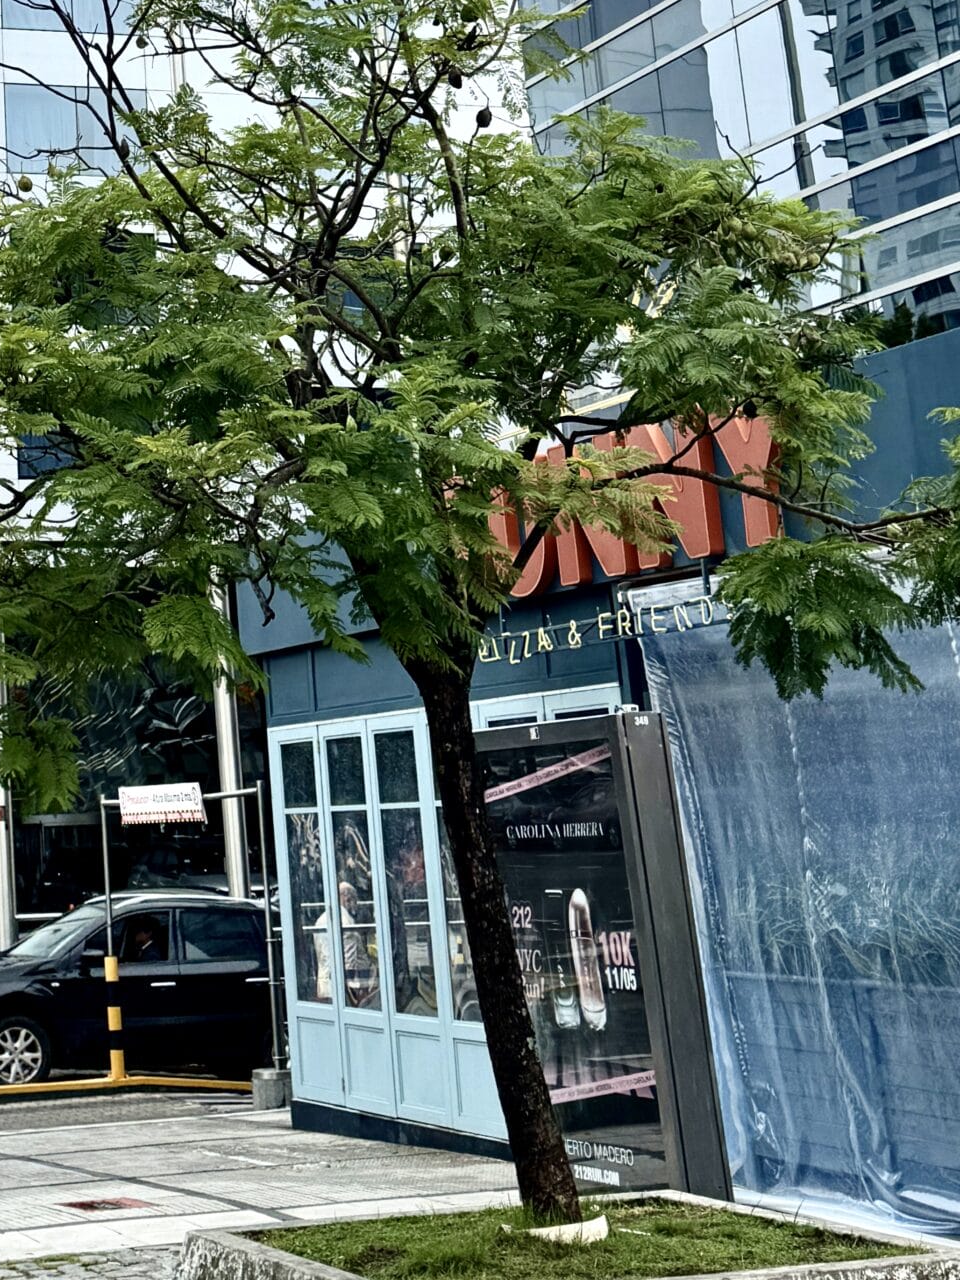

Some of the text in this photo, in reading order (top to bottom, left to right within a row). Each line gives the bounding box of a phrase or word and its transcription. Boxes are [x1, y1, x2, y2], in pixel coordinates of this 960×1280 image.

[442, 412, 782, 598] UNNY
[568, 619, 582, 649] &
[506, 822, 605, 839] CAROLINA HERRERA
[512, 906, 533, 929] 212
[515, 948, 542, 974] NYC
[599, 931, 636, 967] 10K
[605, 967, 638, 992] 11/05
[564, 1138, 635, 1167] ERTO MADERO
